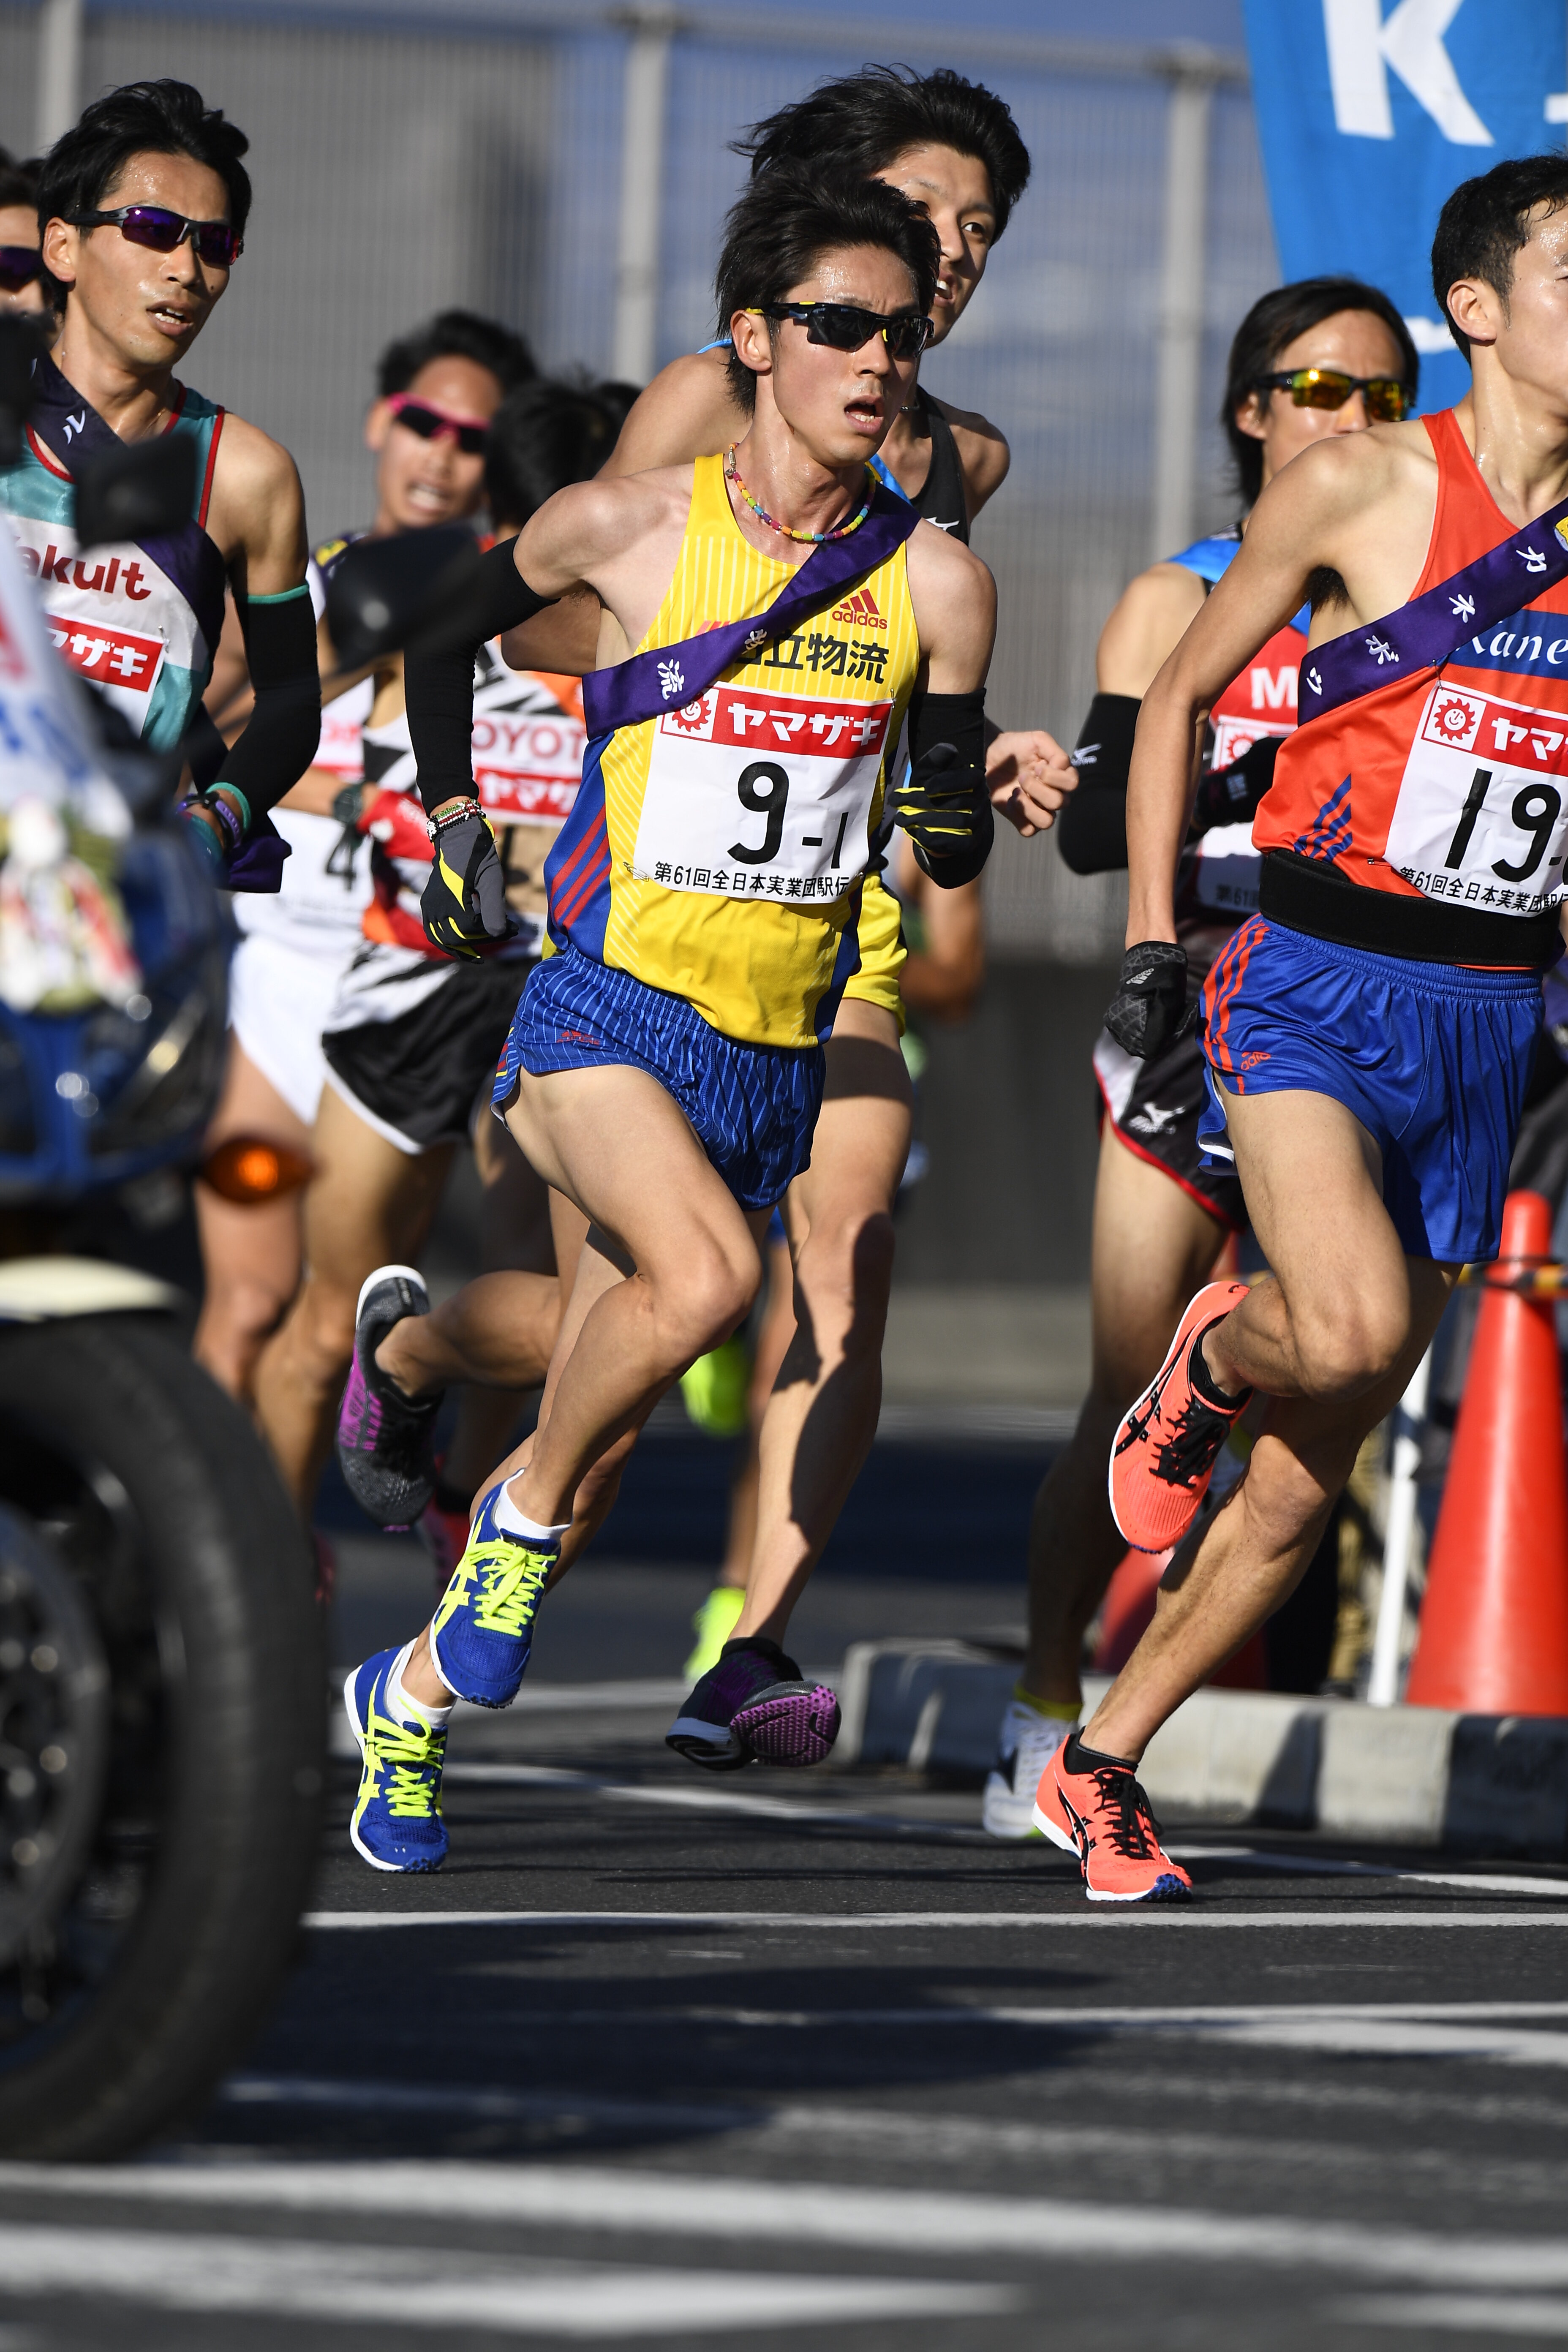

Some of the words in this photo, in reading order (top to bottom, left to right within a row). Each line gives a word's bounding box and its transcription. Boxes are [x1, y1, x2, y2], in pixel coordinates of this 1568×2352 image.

[15, 536, 152, 600] akult
[832, 610, 887, 629] adidas
[727, 702, 882, 746] ヤマザキ
[1491, 717, 1568, 761] ヤマ
[727, 762, 849, 869] 9-1
[1444, 768, 1568, 885] 19-
[653, 860, 850, 898] 第61回全日本実業団駅伝
